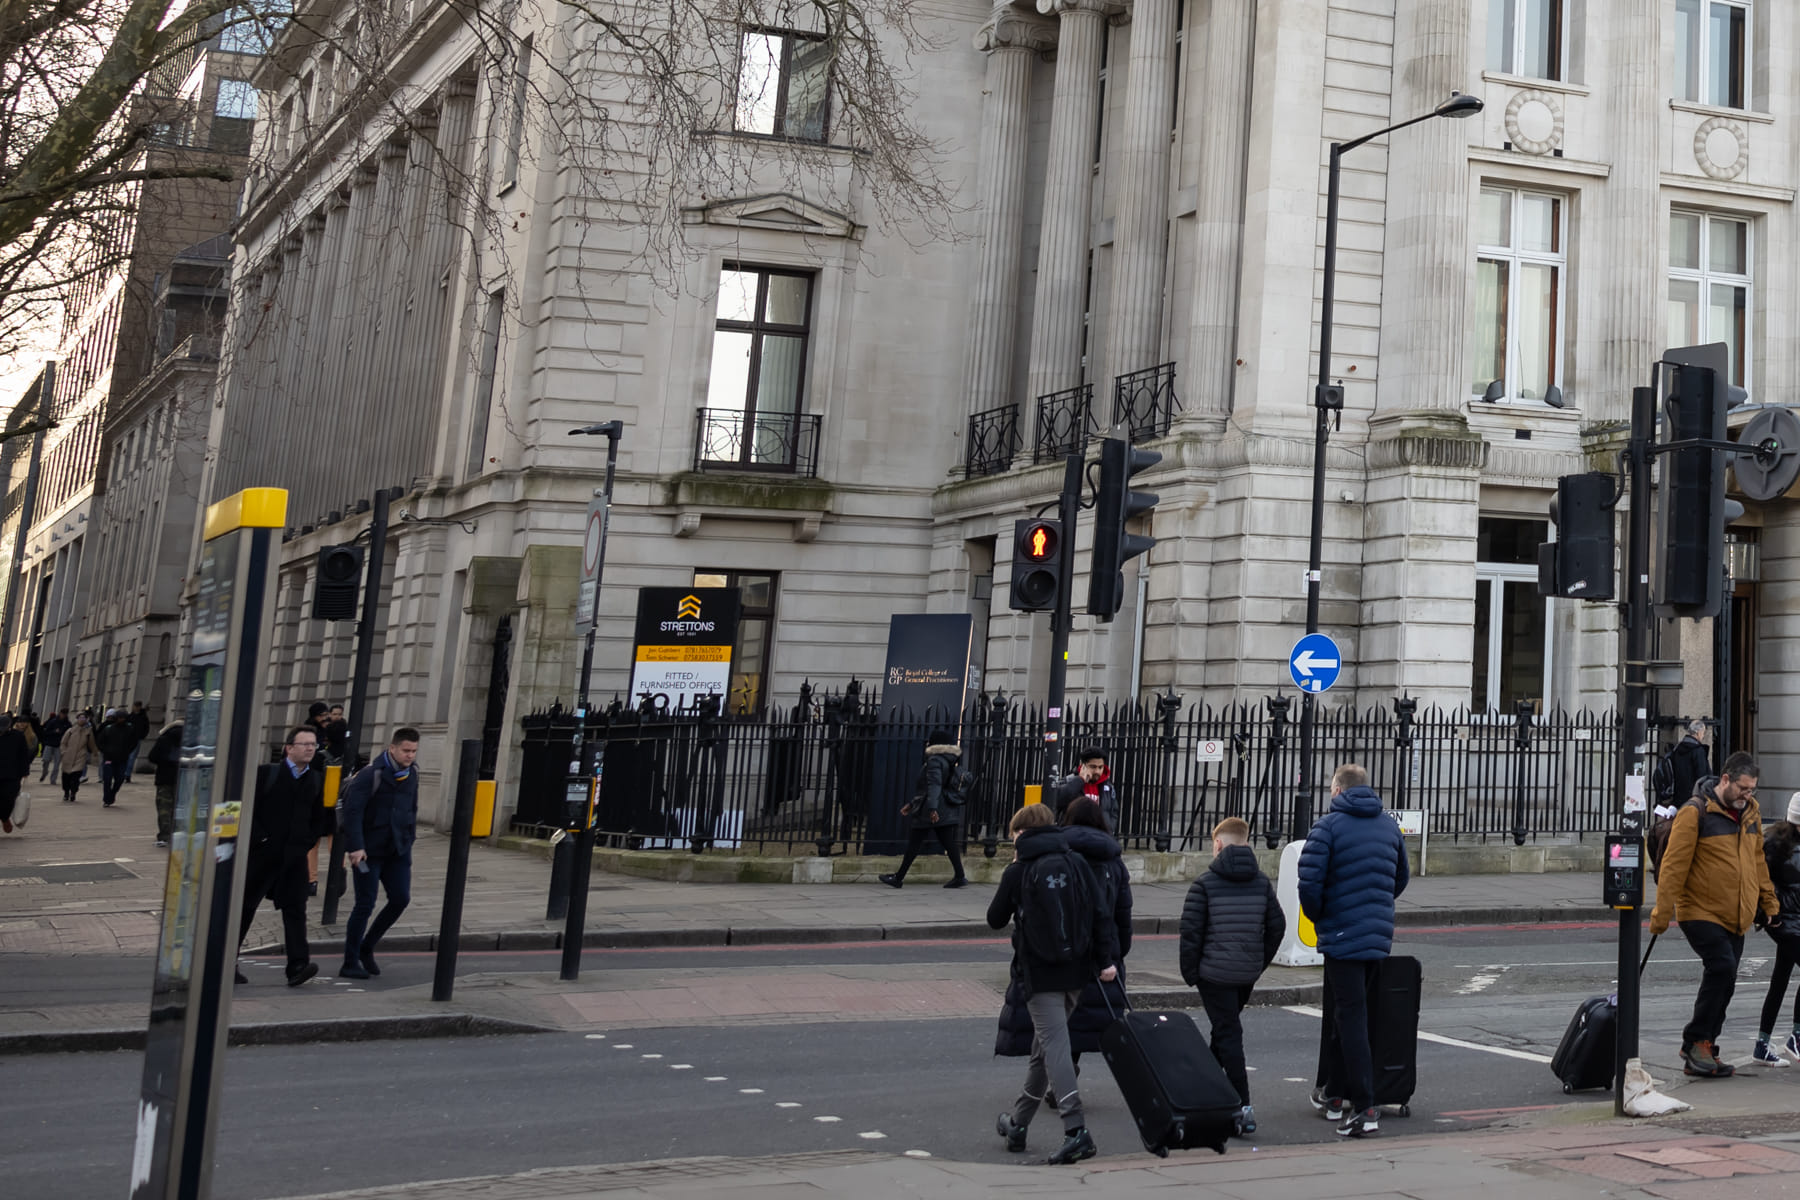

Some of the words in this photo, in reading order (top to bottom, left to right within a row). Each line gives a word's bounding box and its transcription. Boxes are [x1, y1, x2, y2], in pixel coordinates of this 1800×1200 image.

[660, 621, 715, 631] STRETTONS
[665, 672, 693, 680] FITTED
[890, 667, 904, 676] RC
[640, 681, 686, 689] FURNISHED
[689, 681, 721, 689] OFFICES
[889, 676, 903, 685] GP
